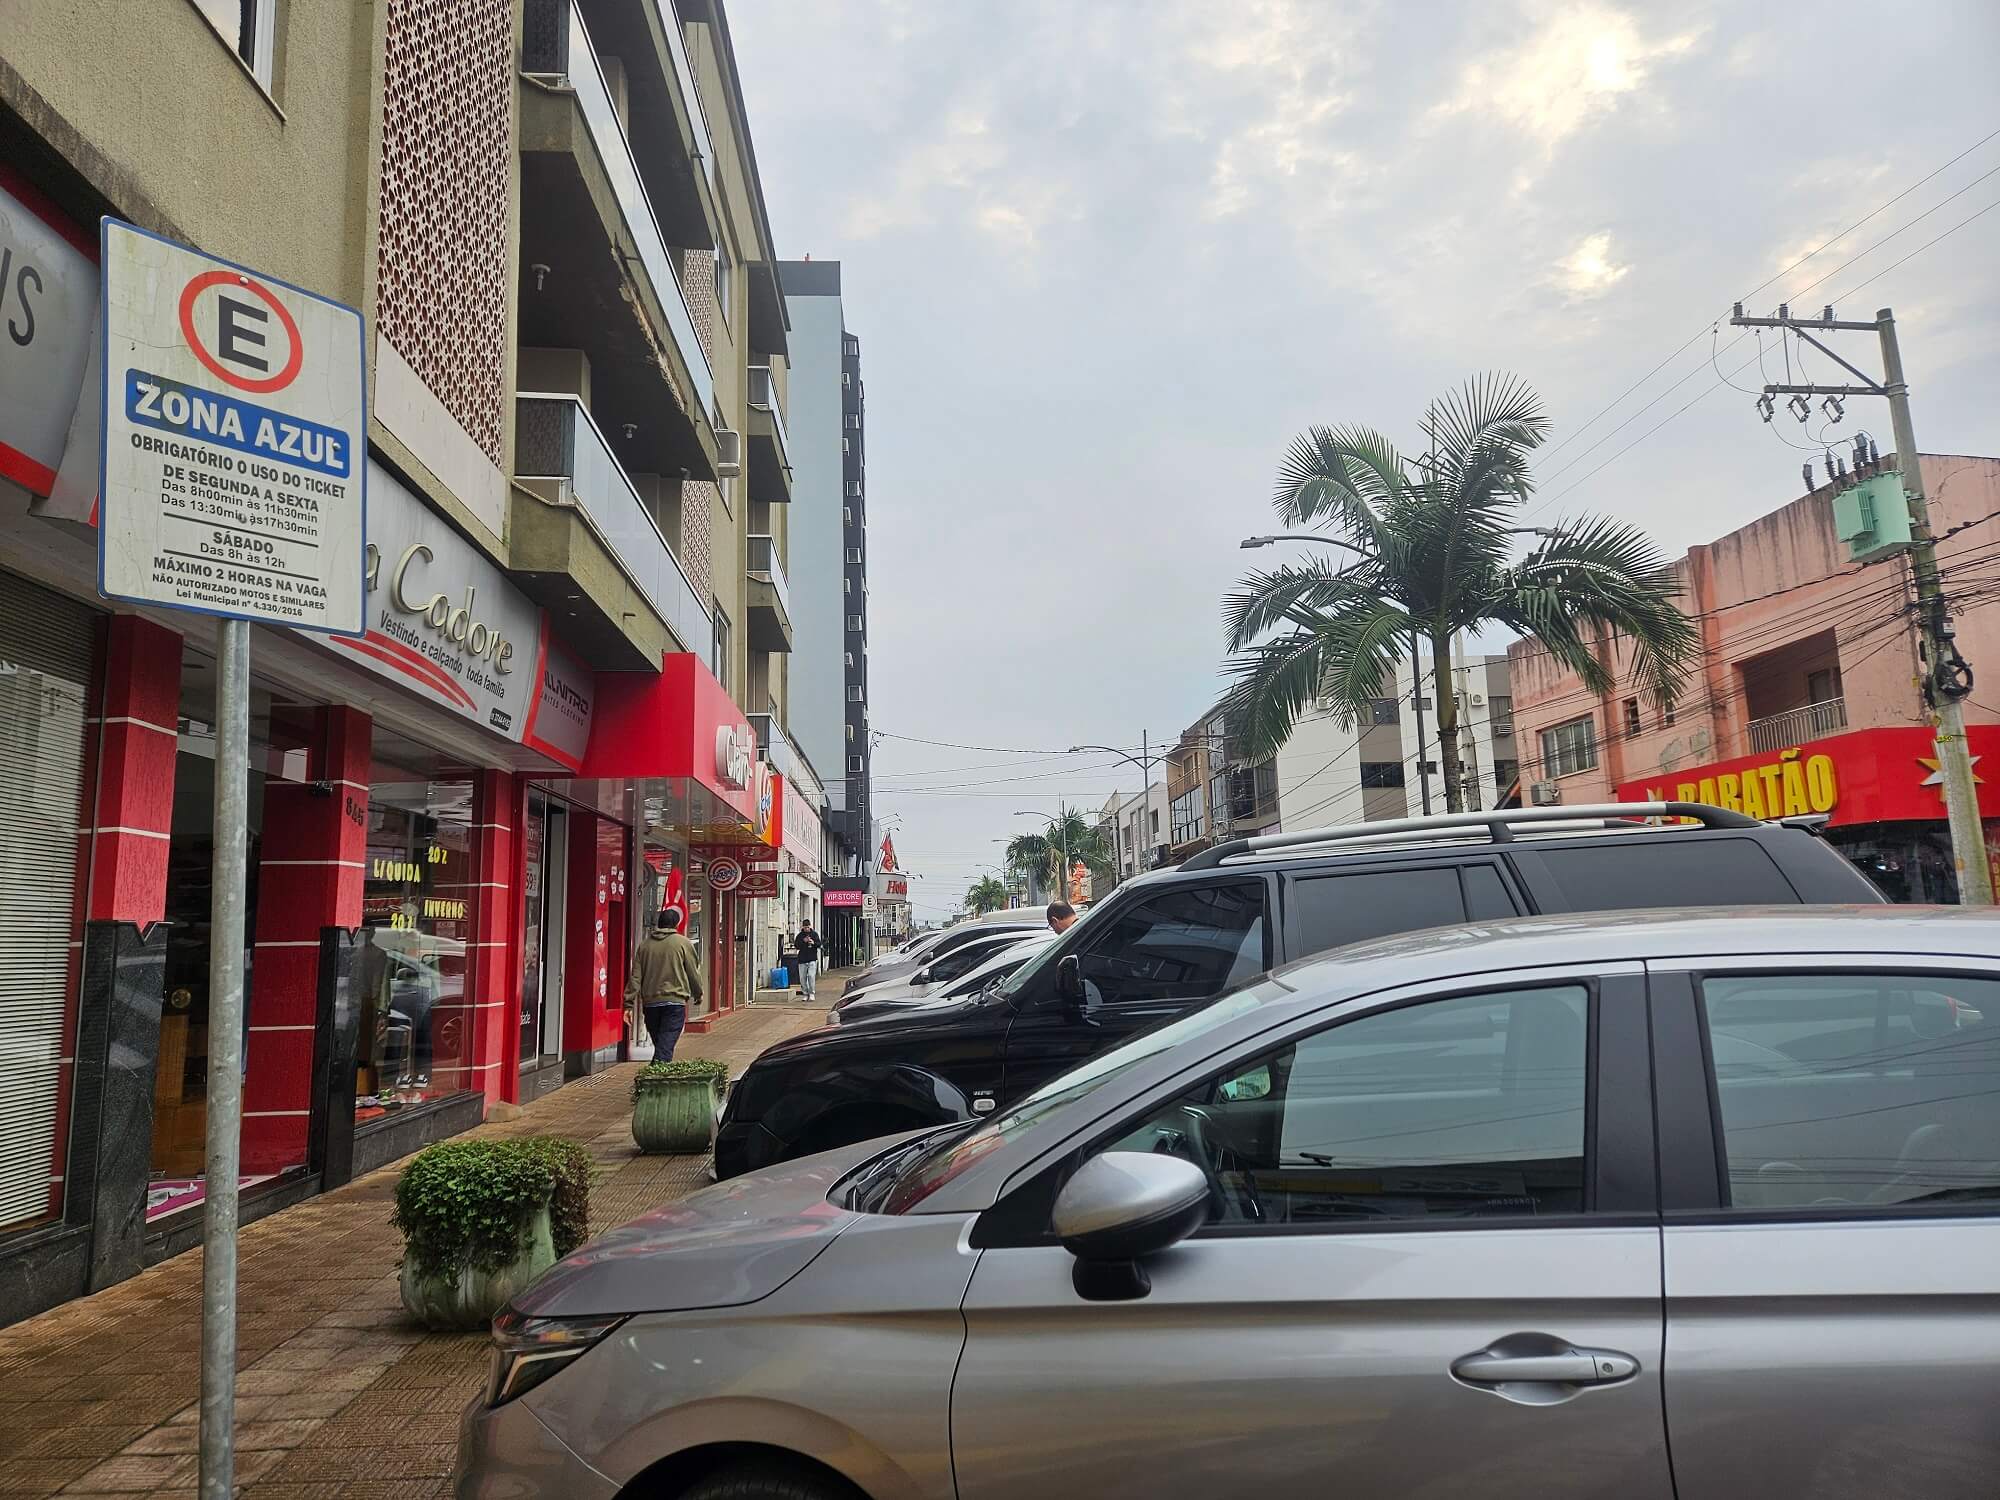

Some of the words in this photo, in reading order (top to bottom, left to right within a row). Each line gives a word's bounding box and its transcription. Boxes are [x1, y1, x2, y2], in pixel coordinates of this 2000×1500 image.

[218, 295, 268, 372] E
[135, 381, 245, 442] ZONA
[254, 417, 344, 470] AZUL
[131, 433, 234, 470] OBRIGATÓRIO
[238, 460, 247, 474] O
[251, 463, 278, 482] USO
[282, 473, 301, 488] DO
[304, 476, 346, 499] TICKET
[161, 493, 186, 508] Das
[162, 479, 186, 494] Das
[190, 484, 243, 507] 8h00min
[247, 497, 261, 511] às
[265, 502, 318, 524] 11h30min
[163, 464, 184, 480] DE
[188, 470, 260, 498] SEGUNDA
[264, 489, 274, 502] A
[277, 491, 319, 513] SEXTA
[200, 543, 224, 557] Das
[228, 548, 243, 560] 8h
[247, 552, 261, 564] às
[265, 556, 286, 569] 12h
[212, 531, 274, 554] SÁBADO
[152, 573, 174, 585] NÃO
[176, 578, 237, 595] AUTORIZADO
[239, 588, 270, 601] MOTOS
[273, 594, 279, 602] E
[280, 595, 326, 610] SIMILARES
[153, 557, 212, 577] MÁXIMO
[216, 568, 225, 579] 2
[228, 570, 273, 588] HORAS
[276, 579, 293, 592] NA
[295, 582, 327, 598] VAGA
[176, 588, 191, 598] Lei
[193, 591, 240, 607] Municipal
[253, 601, 303, 617] 4.330/2016
[391, 543, 513, 675] Cadore
[380, 609, 420, 648] Vestindo
[420, 642, 427, 654] e
[428, 644, 463, 675] calçando
[466, 665, 484, 686] toda
[1677, 748, 1838, 826] BARATÃO
[373, 858, 421, 884] LIQUIDA
[424, 899, 464, 920] INVERNO
[826, 893, 837, 901] VIP
[838, 893, 860, 901] STORE
